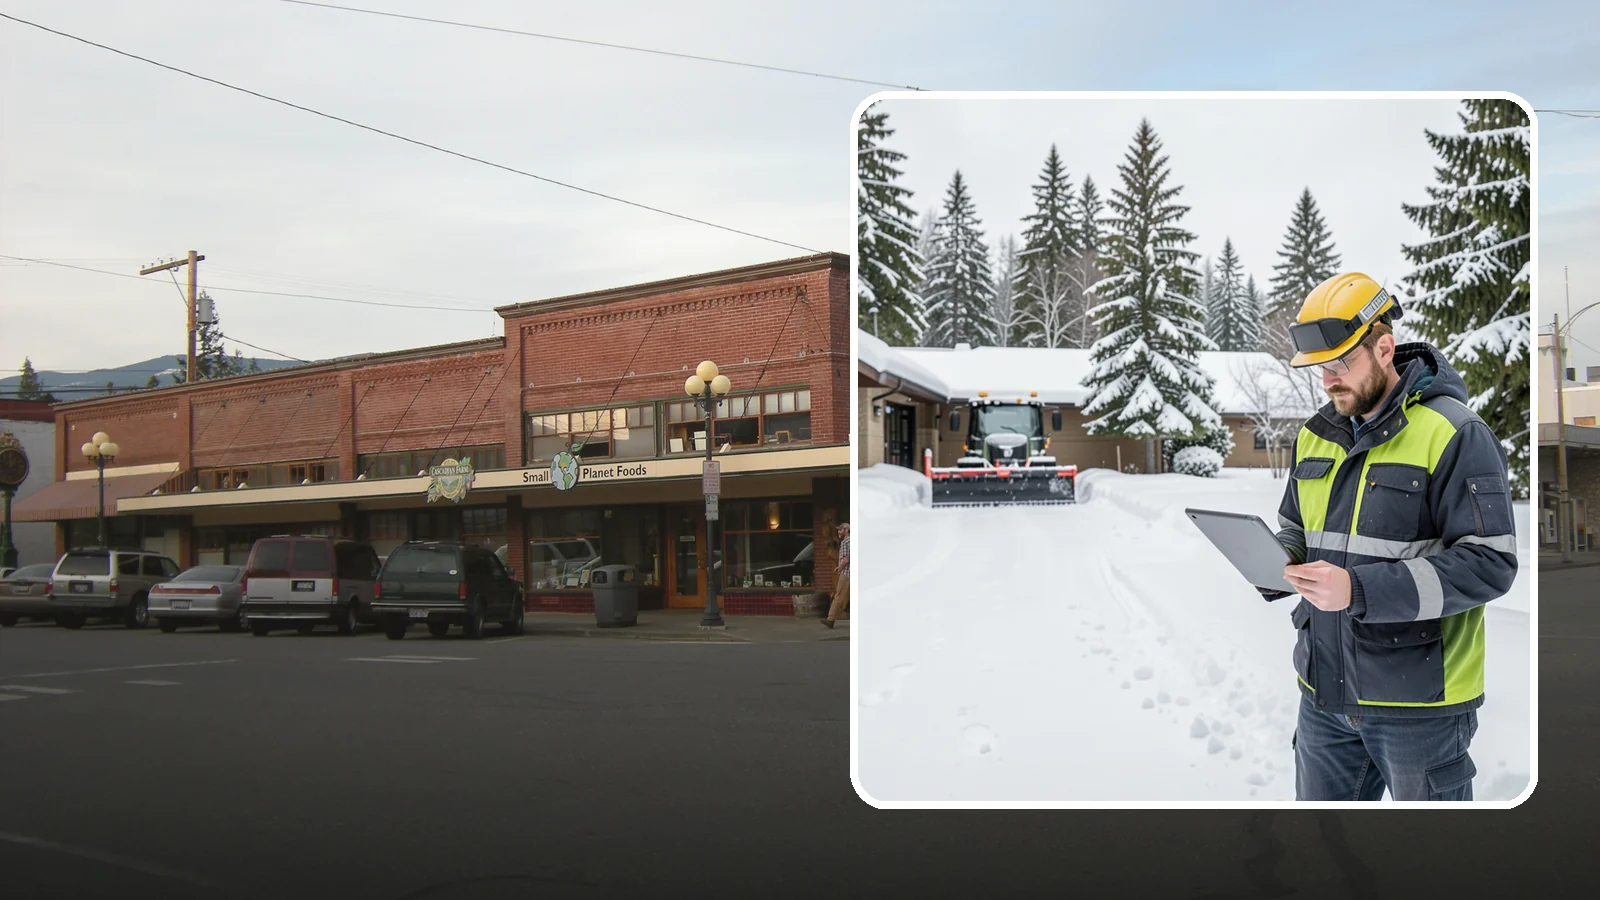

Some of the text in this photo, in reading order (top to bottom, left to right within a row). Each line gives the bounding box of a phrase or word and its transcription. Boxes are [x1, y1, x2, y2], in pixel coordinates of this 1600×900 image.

[522, 464, 647, 483] Small Planet Foods
